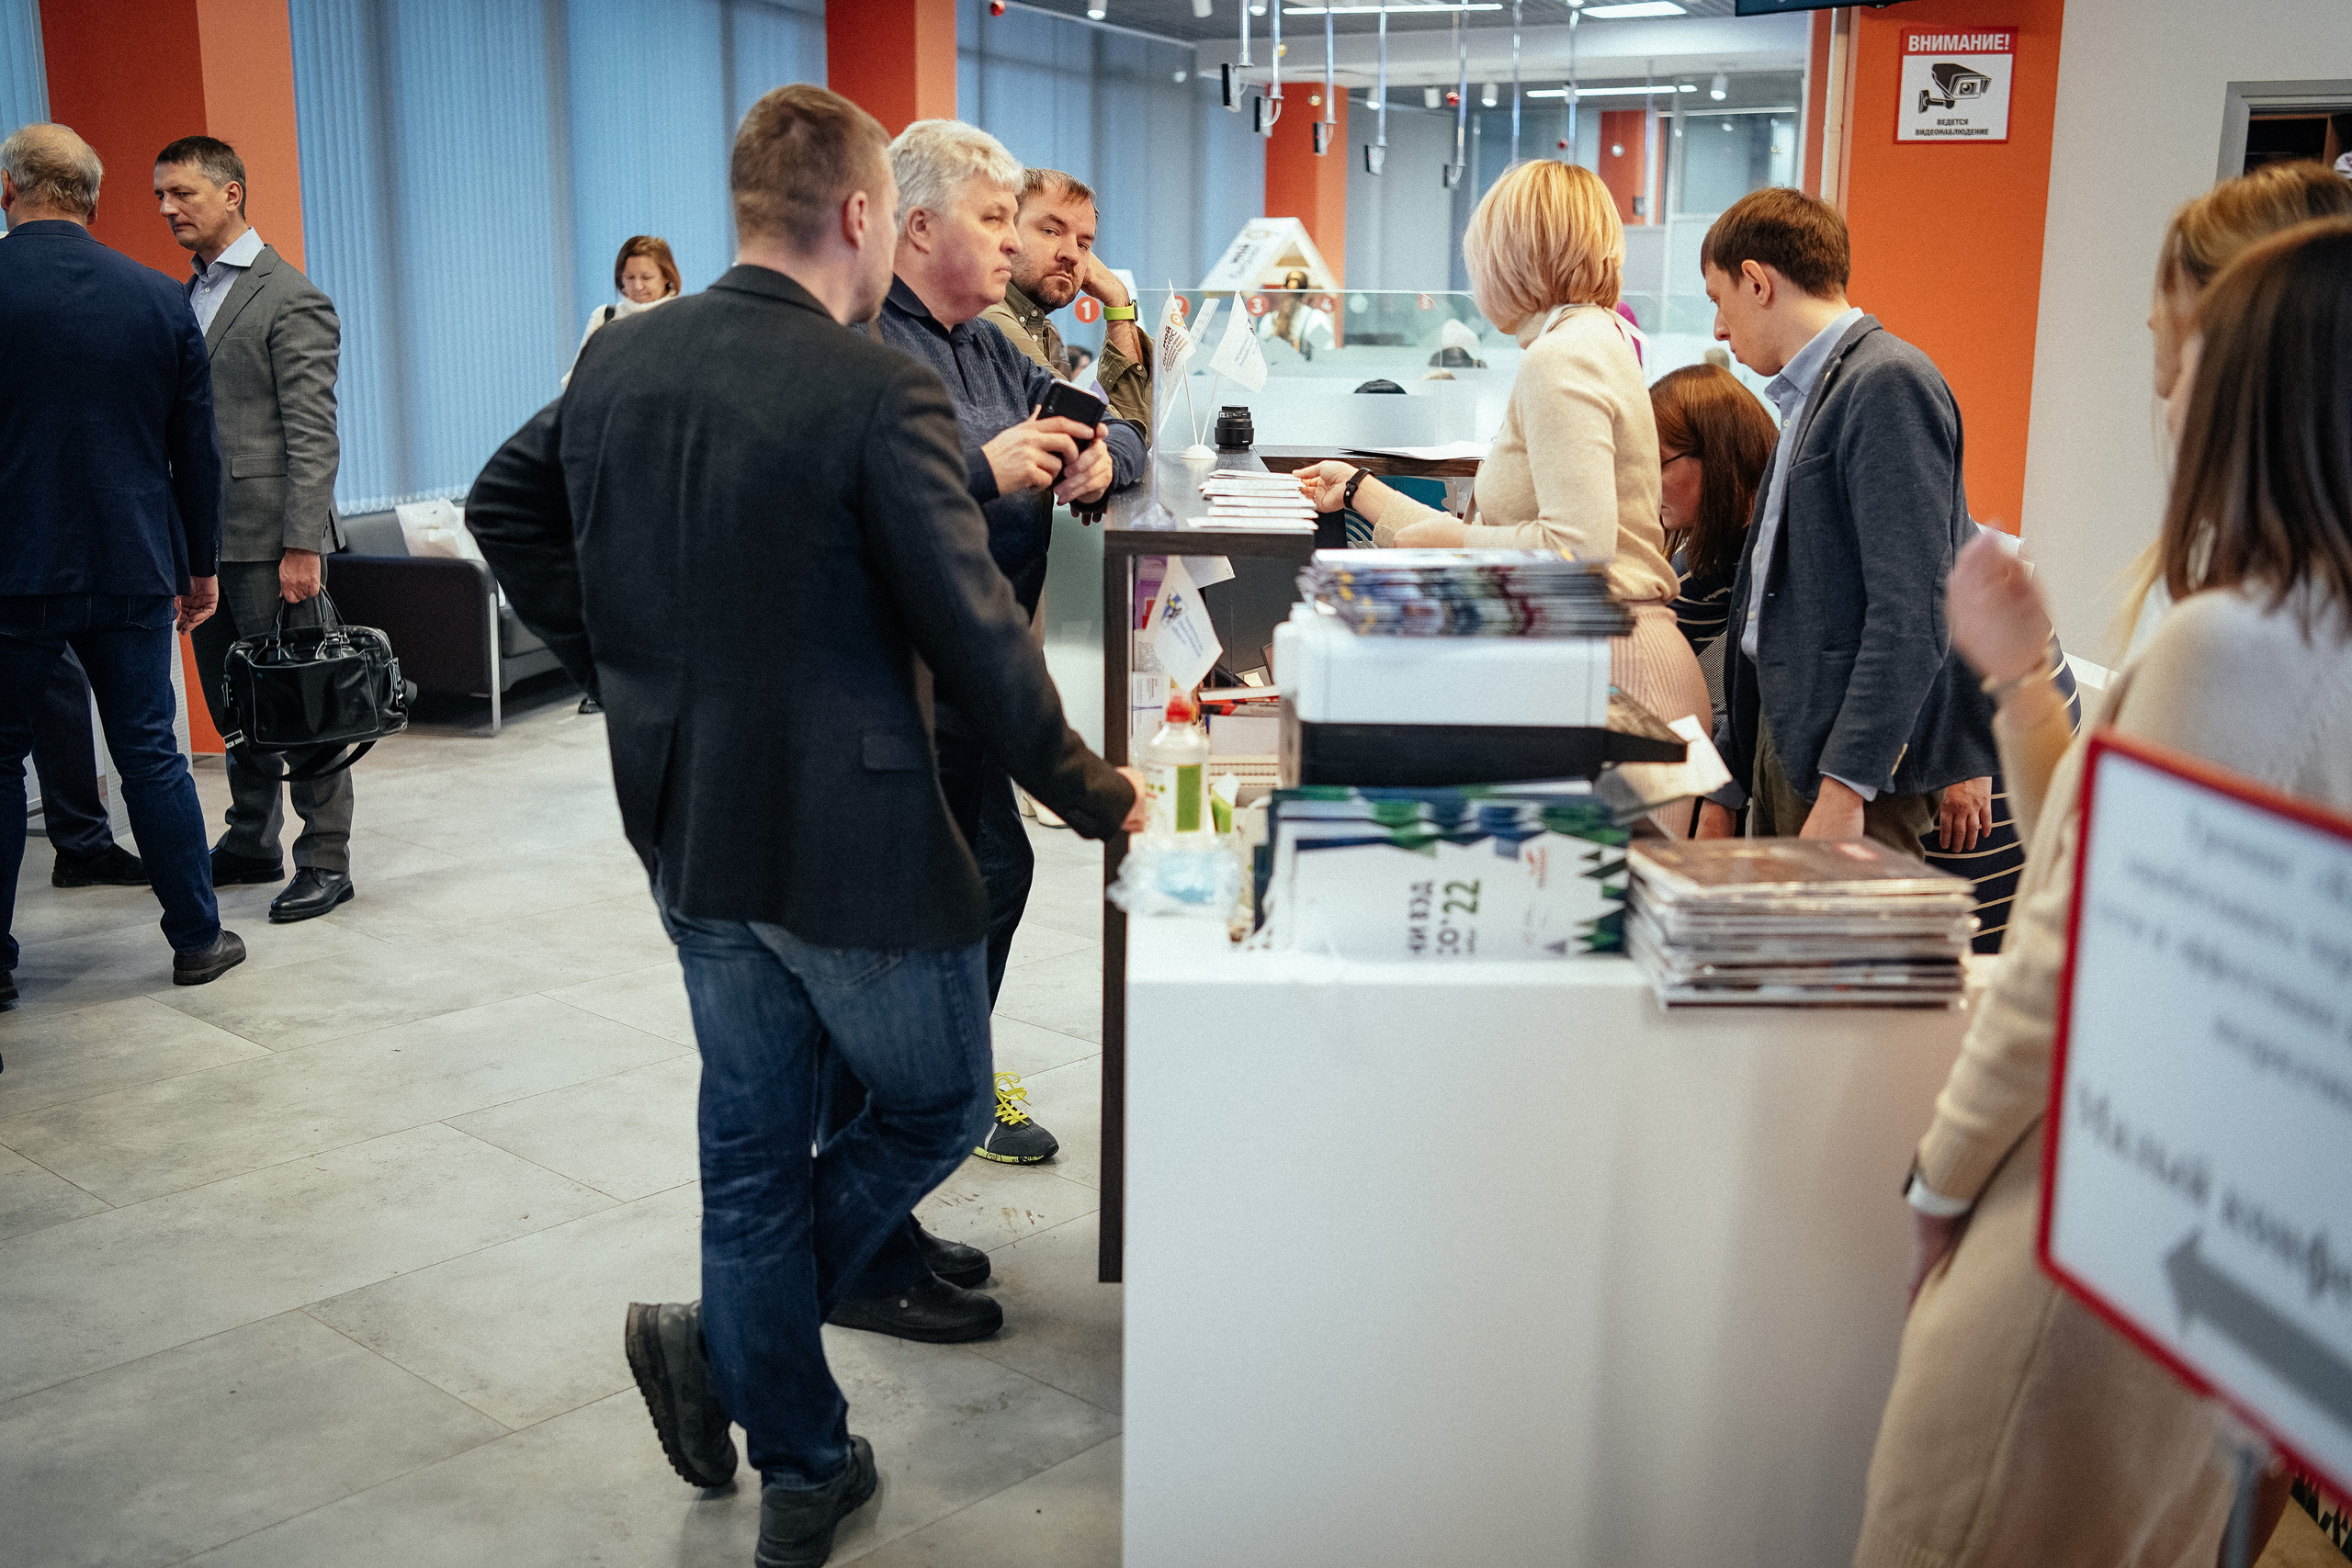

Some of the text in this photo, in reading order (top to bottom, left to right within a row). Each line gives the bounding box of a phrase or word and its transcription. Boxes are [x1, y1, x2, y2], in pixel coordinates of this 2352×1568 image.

[1908, 33, 2010, 52] ВНИМАНИЕ!
[1081, 300, 1091, 321] 1
[1251, 298, 1263, 314] 3
